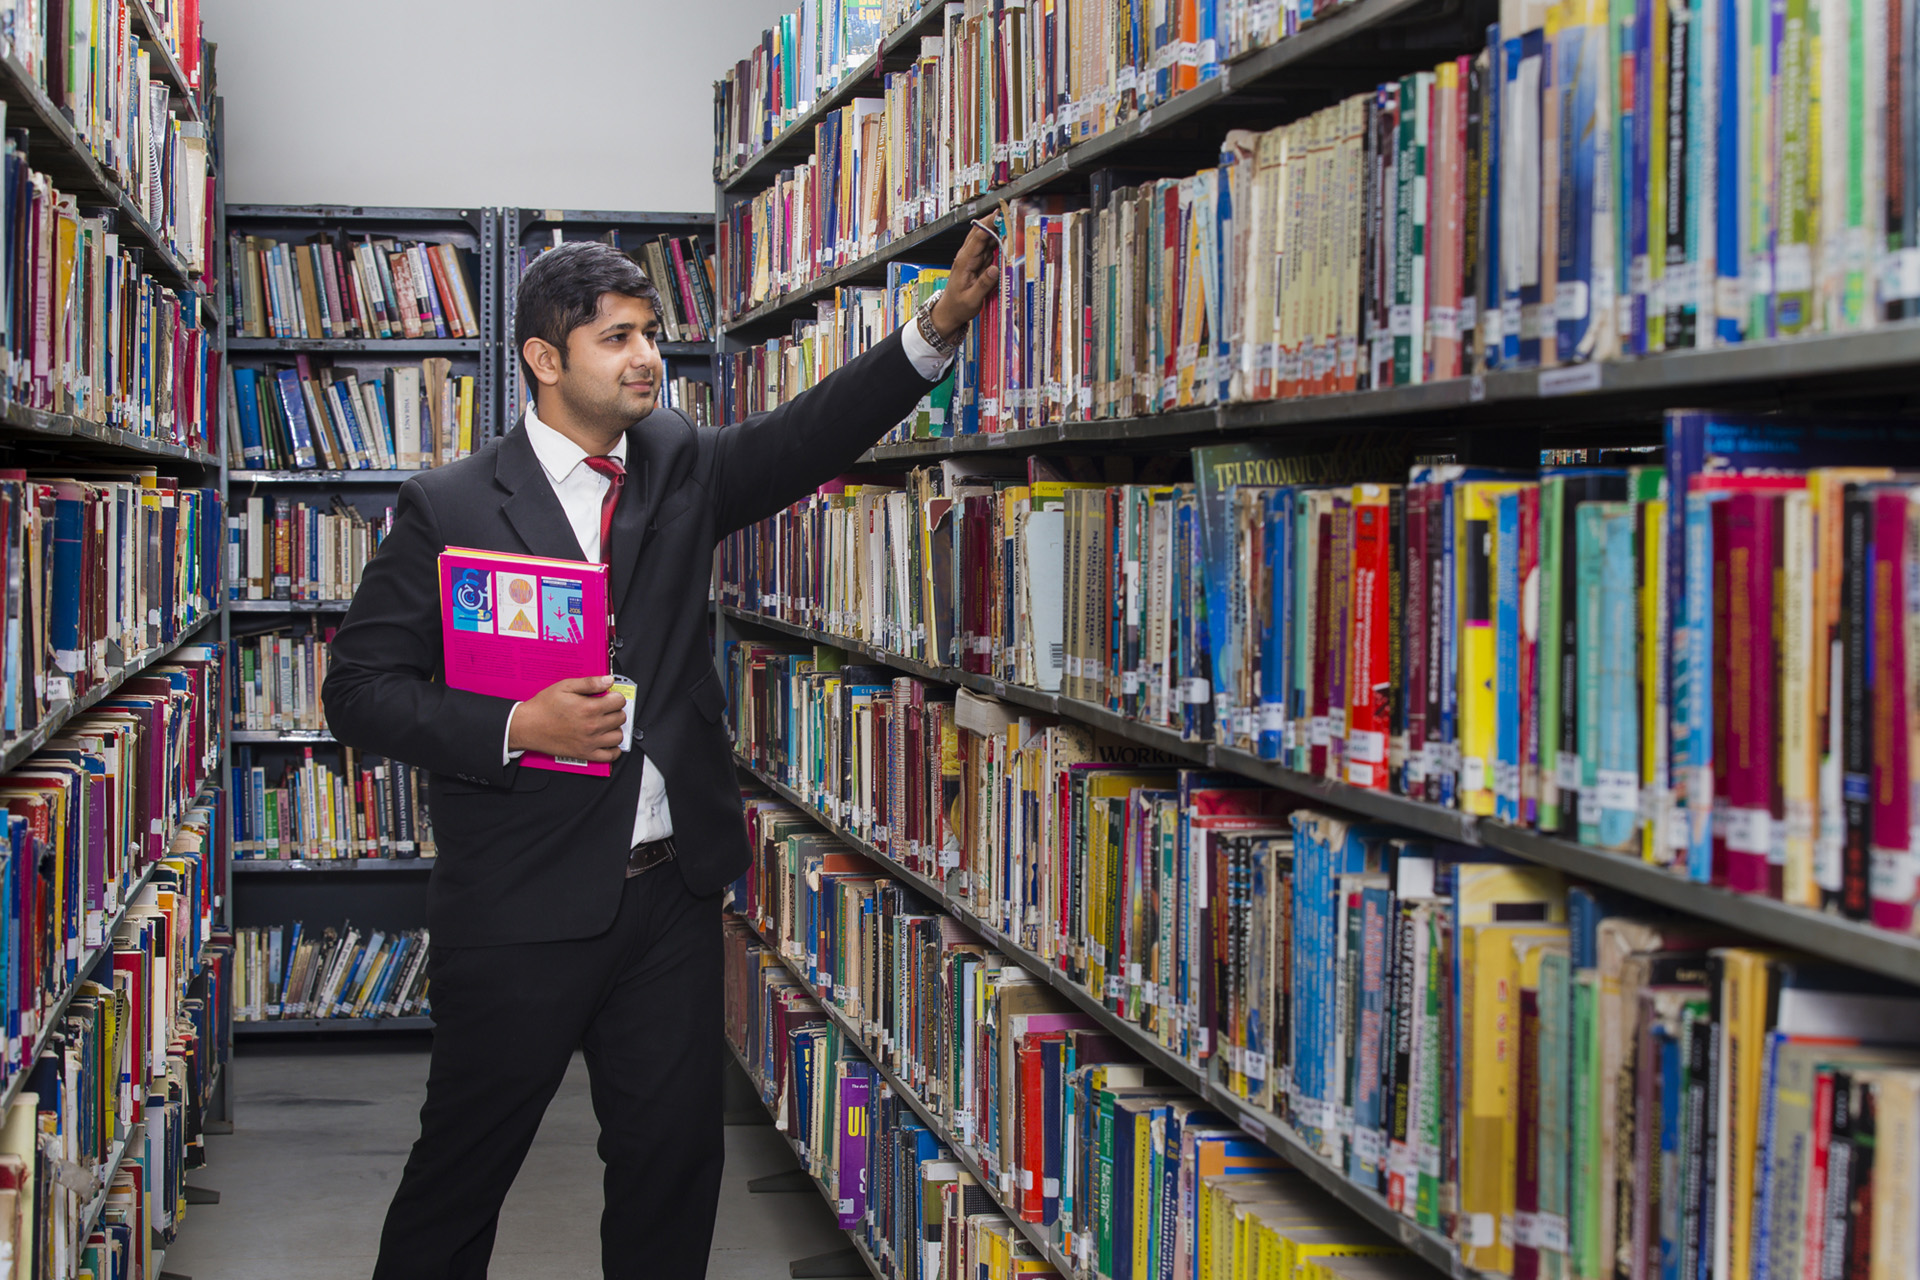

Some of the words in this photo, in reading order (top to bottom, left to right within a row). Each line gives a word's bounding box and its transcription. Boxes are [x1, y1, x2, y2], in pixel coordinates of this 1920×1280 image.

[830, 122, 838, 158] Business
[872, 147, 885, 192] Environment
[1014, 512, 1022, 566] VETERINARY
[1156, 544, 1164, 613] VERILOG
[1356, 568, 1366, 619] System
[1155, 618, 1165, 656] HDL
[1362, 569, 1376, 706] Telecommunication
[1428, 559, 1442, 704] ELECTRONICS
[281, 670, 292, 705] SOCIOLOGY
[1352, 622, 1364, 707] Engineering
[397, 765, 405, 810] ENCYCLOPEDIA
[1228, 848, 1236, 928] ELECTRICAL
[1191, 927, 1199, 966] Design
[1402, 920, 1414, 959] COST
[1346, 949, 1357, 1057] Instrumentation
[1397, 960, 1413, 1053] ACCOUNTING
[1168, 1199, 1177, 1274] Electronic
